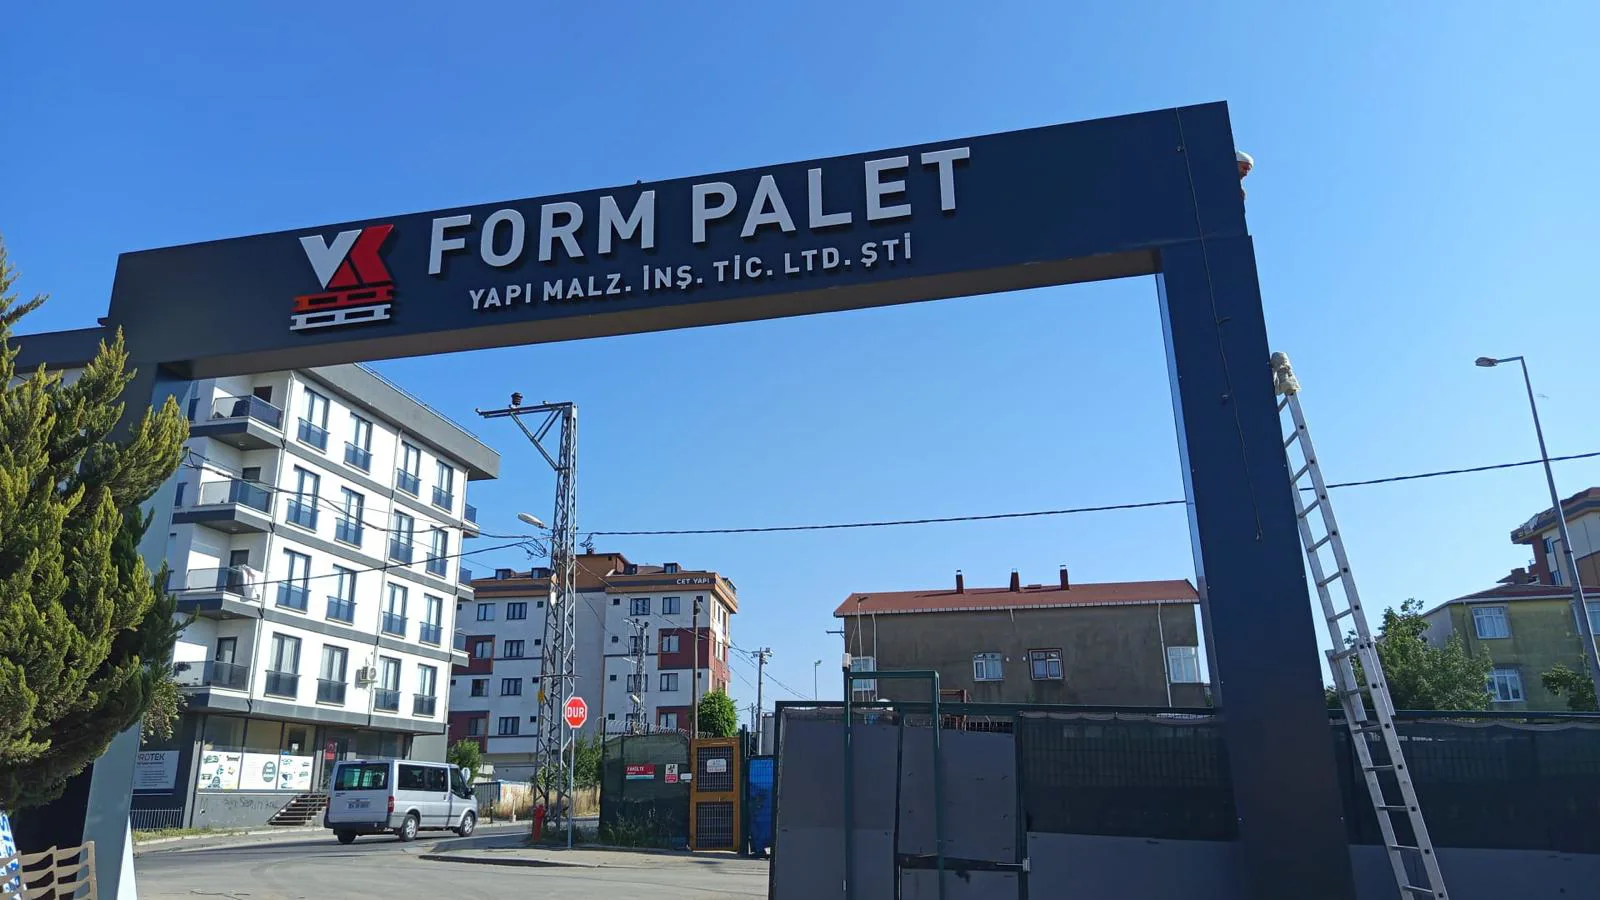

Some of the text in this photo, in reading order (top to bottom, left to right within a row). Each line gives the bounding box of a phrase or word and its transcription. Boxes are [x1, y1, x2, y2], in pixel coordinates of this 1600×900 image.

[427, 146, 971, 275] FORM PALET
[468, 231, 912, 310] YAPI MALZ. İNŞ. TİC. LTD. ŞTİ
[692, 577, 710, 585] YAPI
[567, 706, 585, 718] DUR
